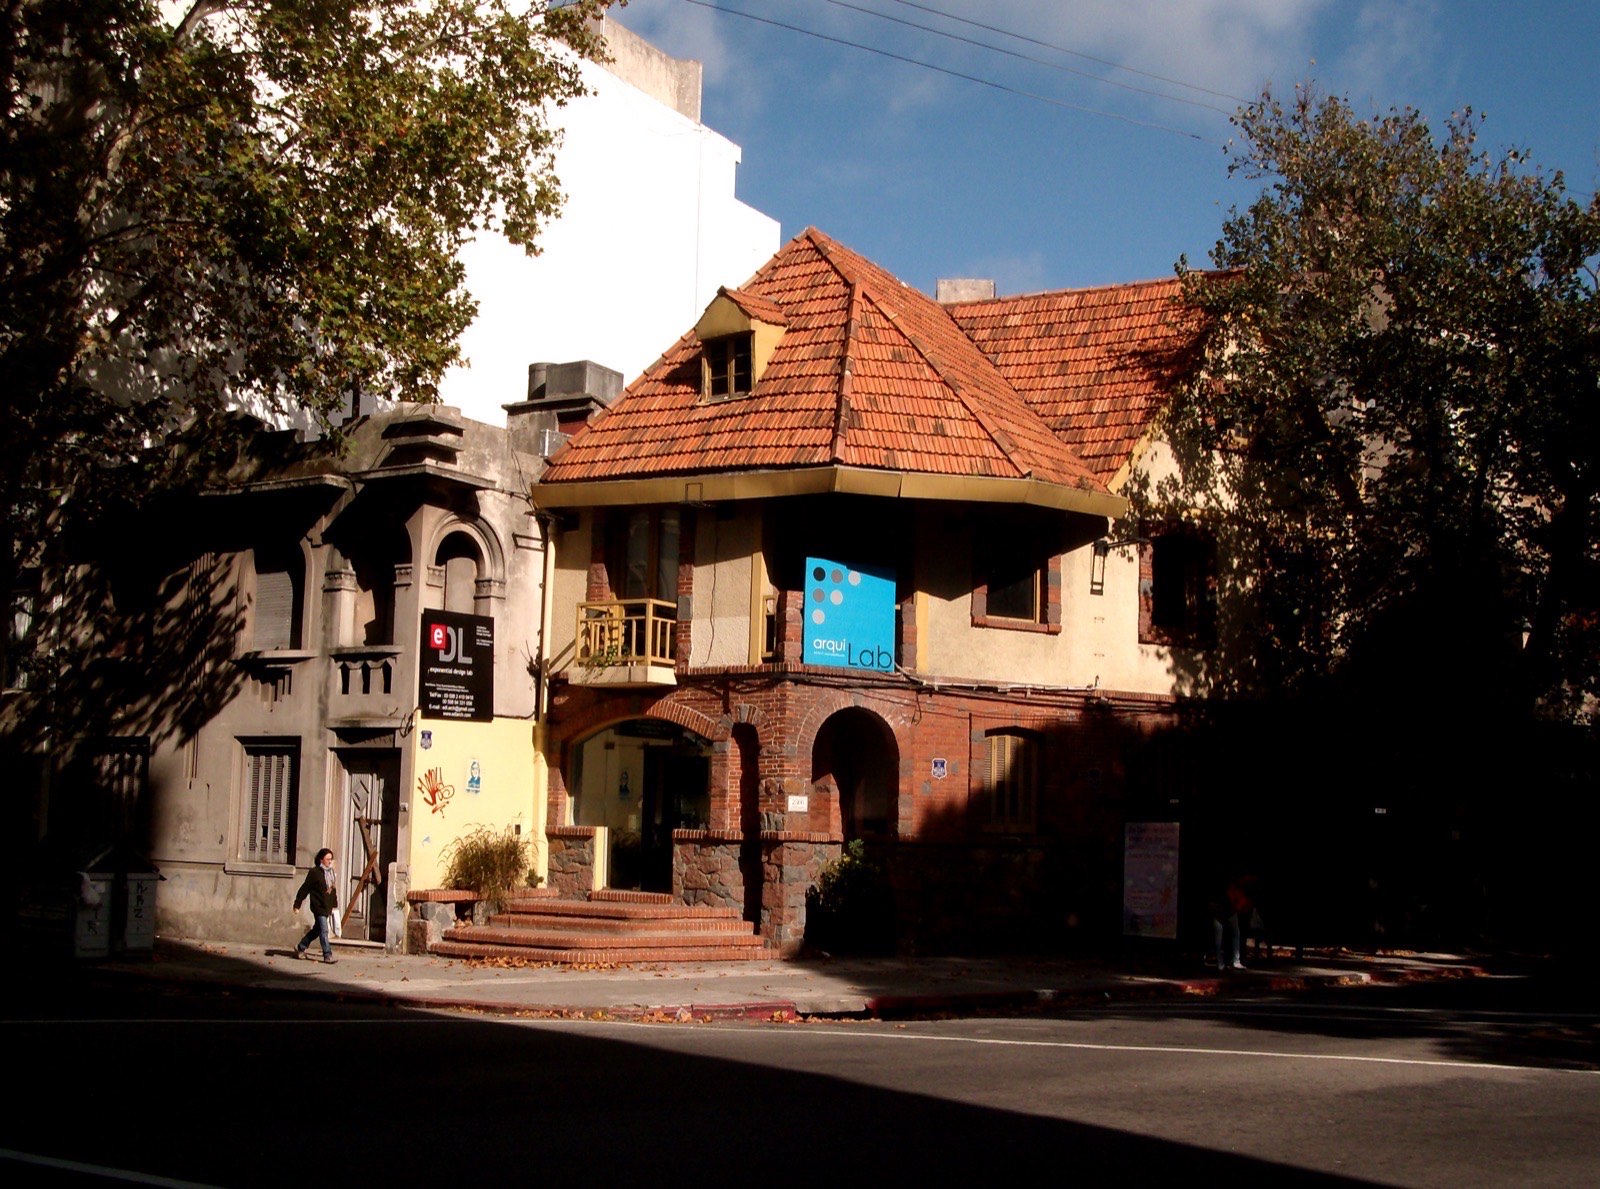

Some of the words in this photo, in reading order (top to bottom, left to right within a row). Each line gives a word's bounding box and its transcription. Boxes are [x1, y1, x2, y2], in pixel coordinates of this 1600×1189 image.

[813, 638, 846, 653] arqui
[848, 643, 892, 669] Lab
[453, 668, 466, 676] design
